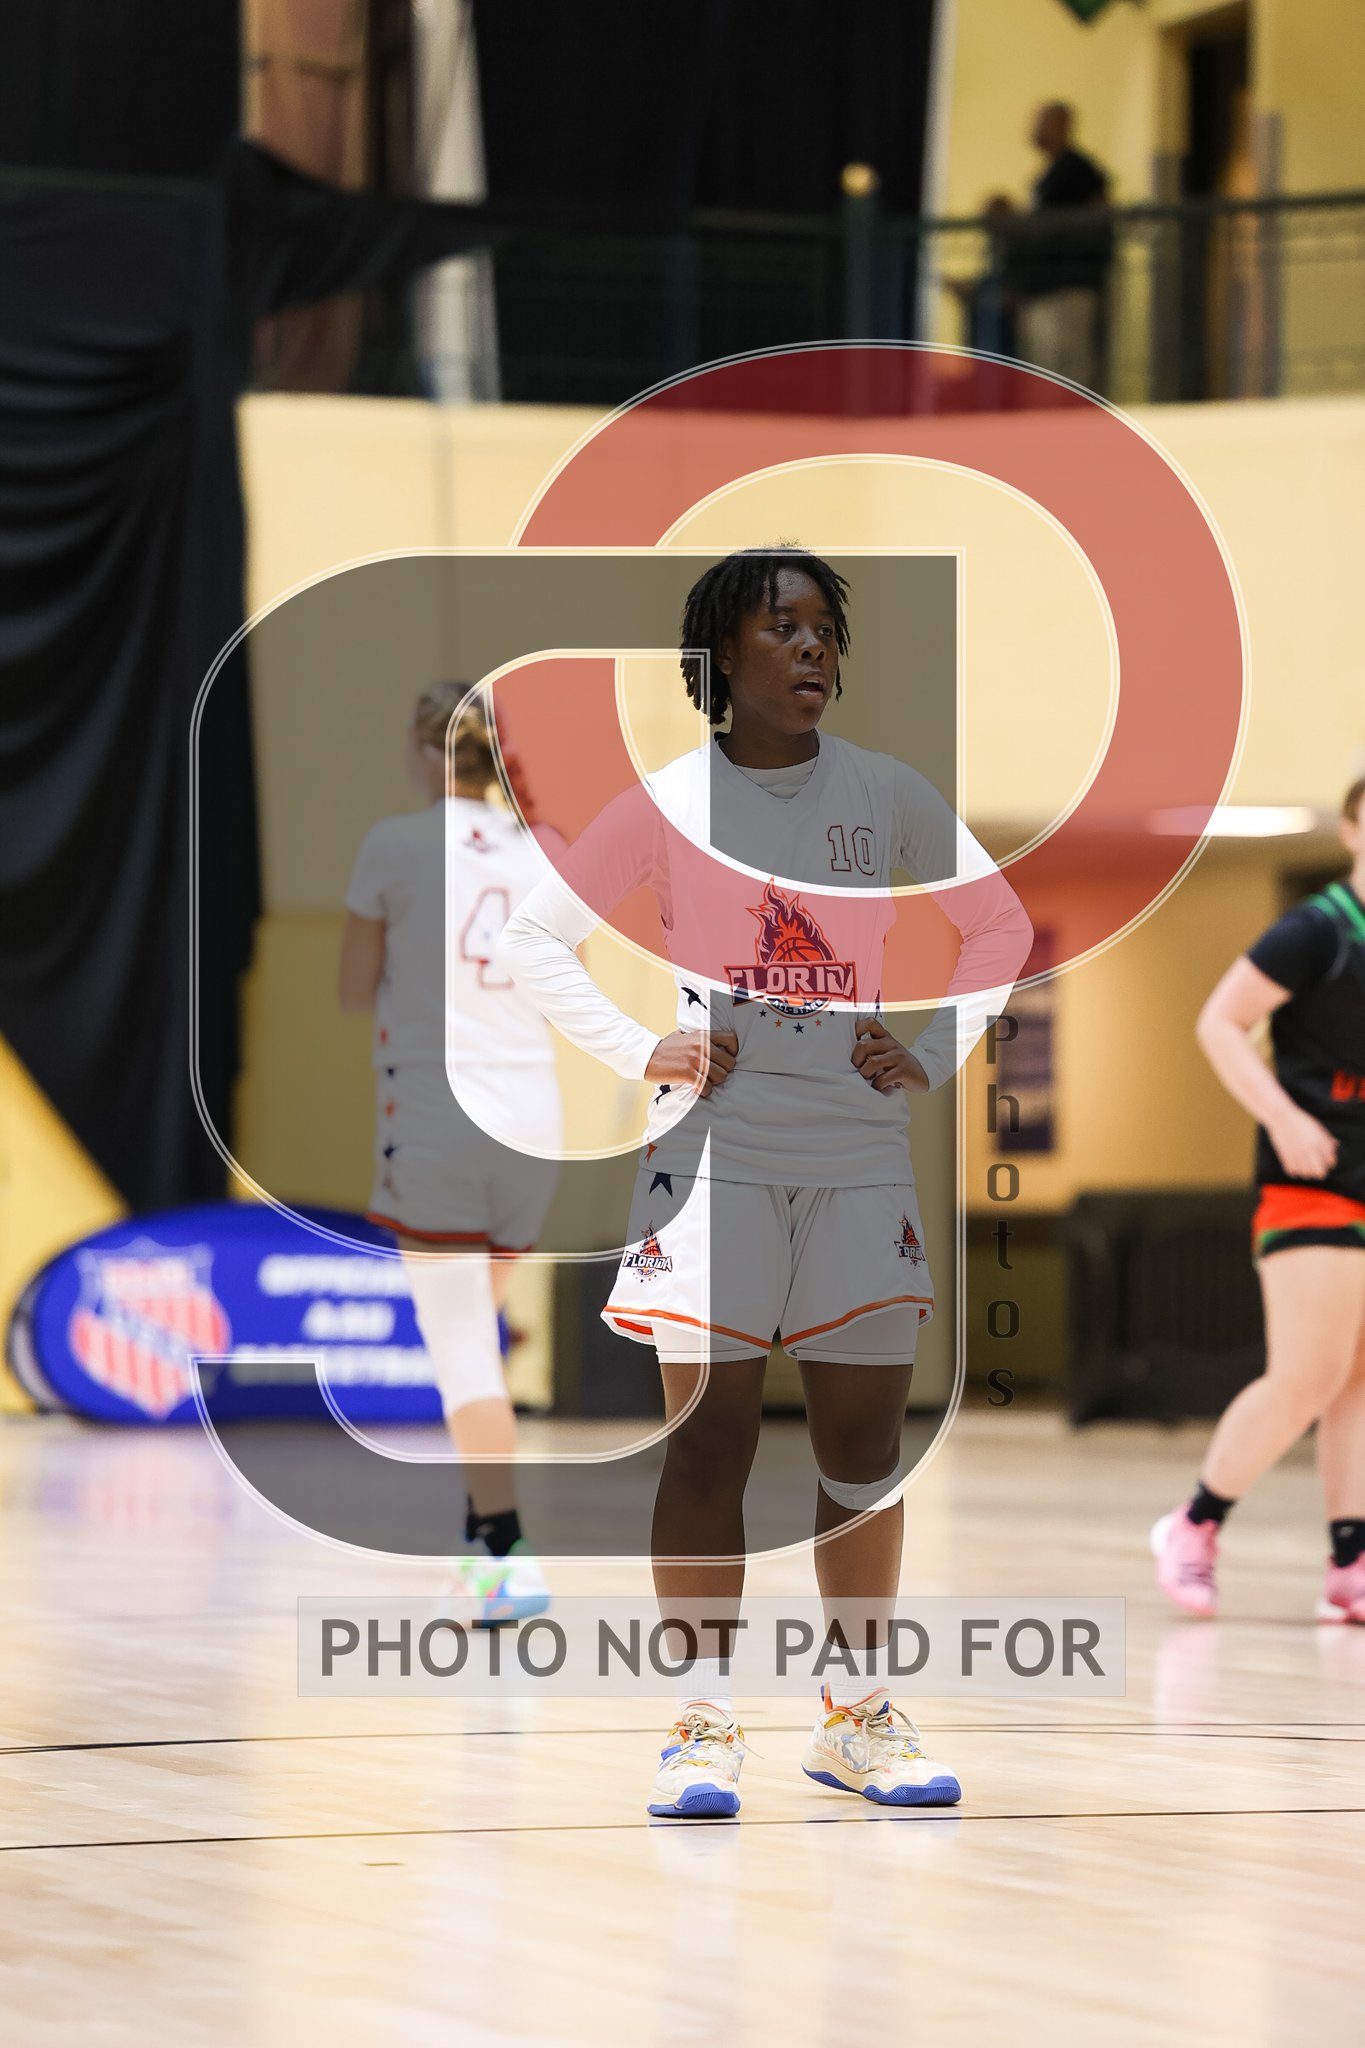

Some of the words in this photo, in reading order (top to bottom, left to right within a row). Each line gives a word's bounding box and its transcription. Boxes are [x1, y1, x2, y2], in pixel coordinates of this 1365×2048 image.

[827, 824, 876, 876] 10
[459, 886, 516, 990] 4
[622, 1253, 673, 1272] FLORIDA
